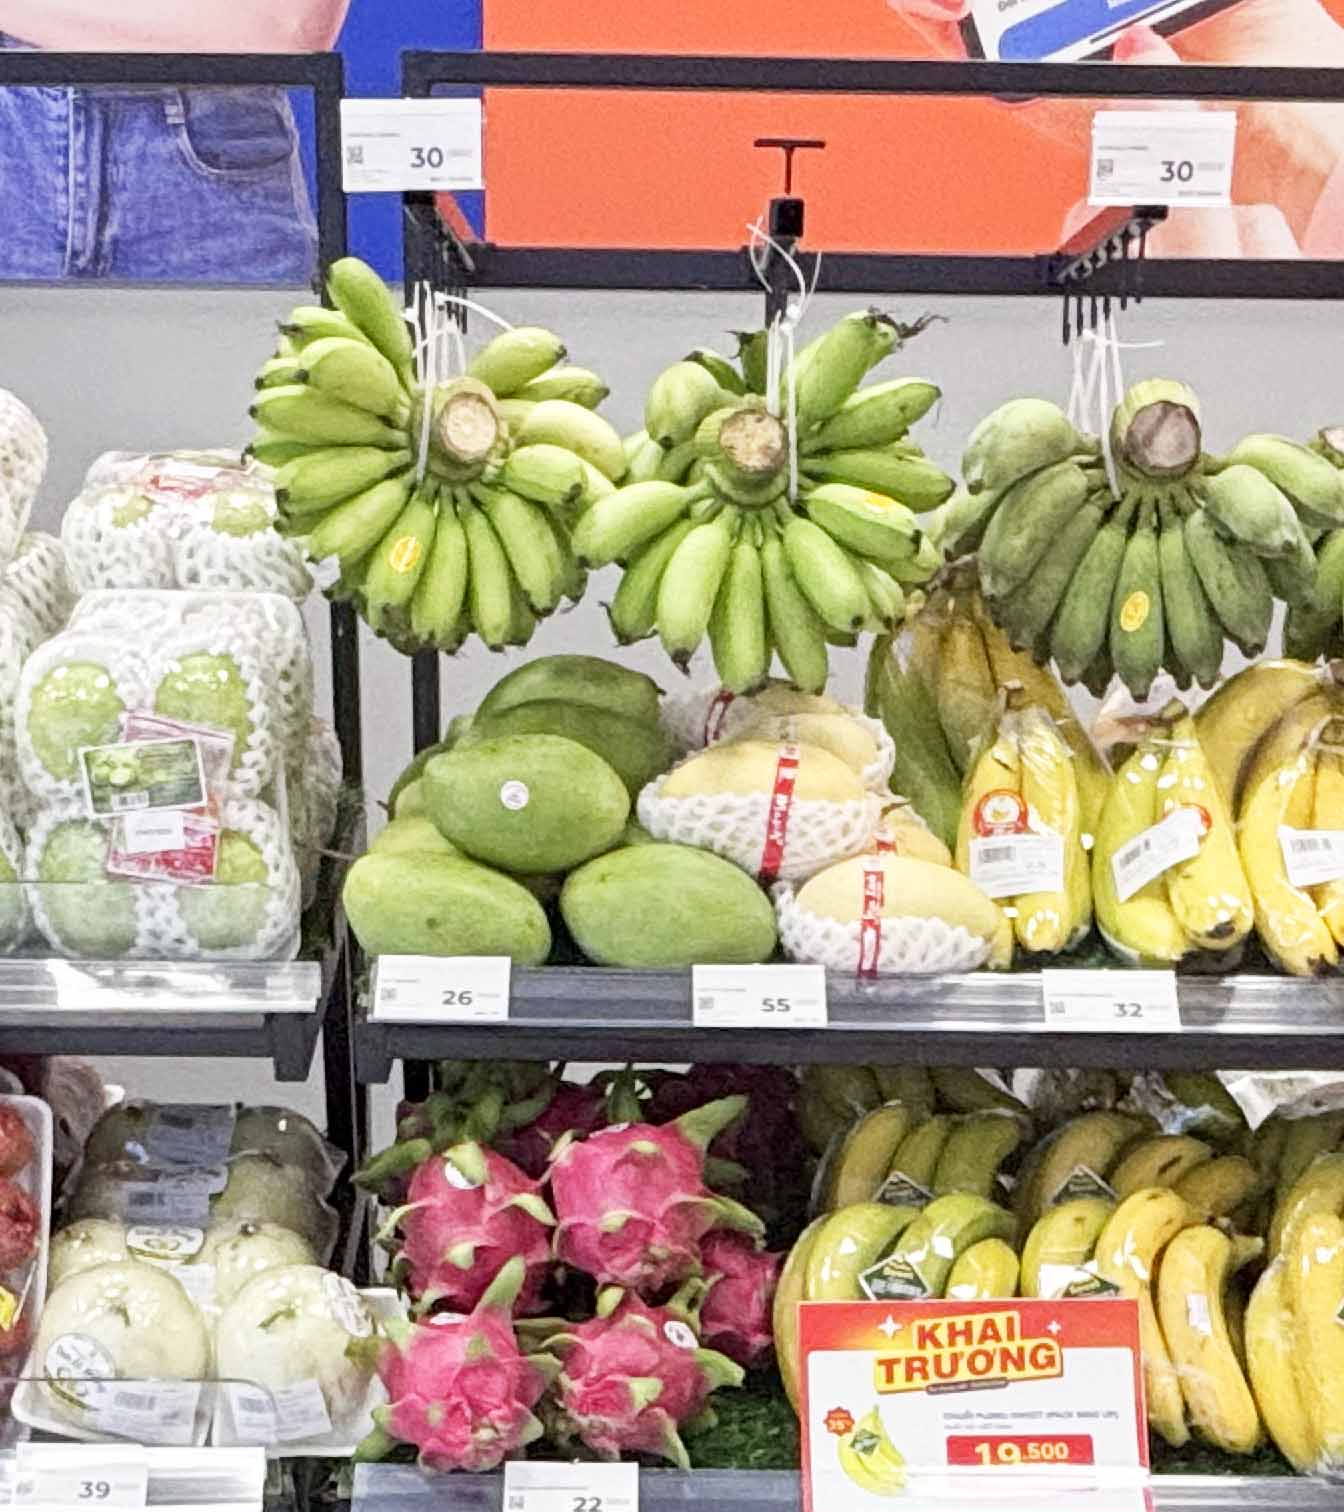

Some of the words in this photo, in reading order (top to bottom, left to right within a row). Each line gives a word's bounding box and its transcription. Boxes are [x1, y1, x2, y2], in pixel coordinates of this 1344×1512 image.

[410, 147, 444, 169] 30
[1160, 160, 1194, 183] 30
[442, 990, 473, 1006] 26
[761, 997, 791, 1013] 55
[1114, 1002, 1143, 1018] 32
[916, 1315, 1016, 1351] KHAI
[876, 1341, 1057, 1385] TRƯƠNG
[79, 1481, 111, 1499] 39
